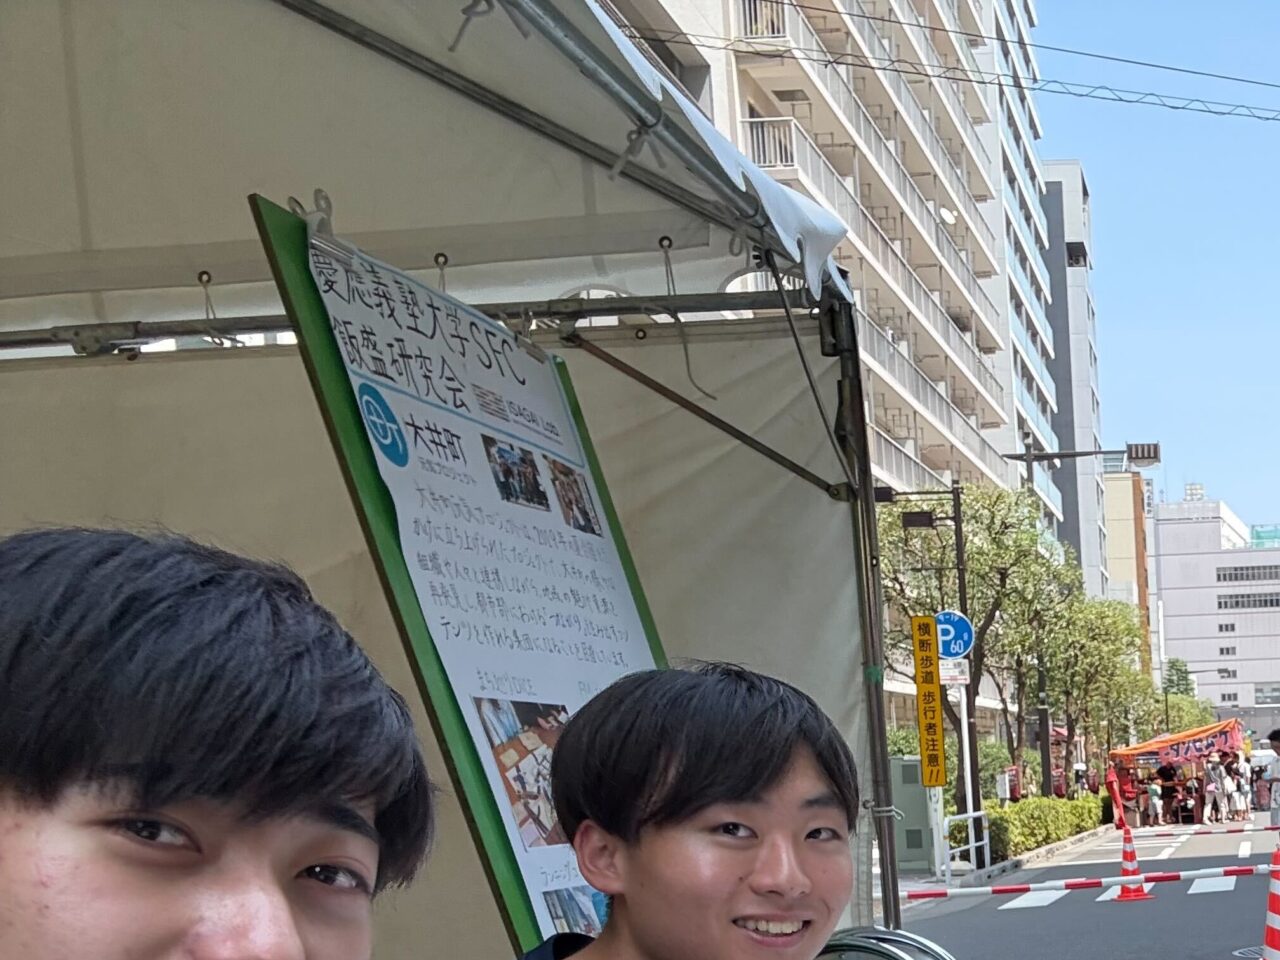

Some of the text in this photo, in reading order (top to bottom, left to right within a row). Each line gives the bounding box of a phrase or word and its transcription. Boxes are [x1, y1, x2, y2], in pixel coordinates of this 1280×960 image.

[333, 316, 470, 413] 飯盛研究会
[403, 413, 467, 467] 大井町
[917, 622, 935, 685] 横断歩道
[950, 640, 964, 653] 60
